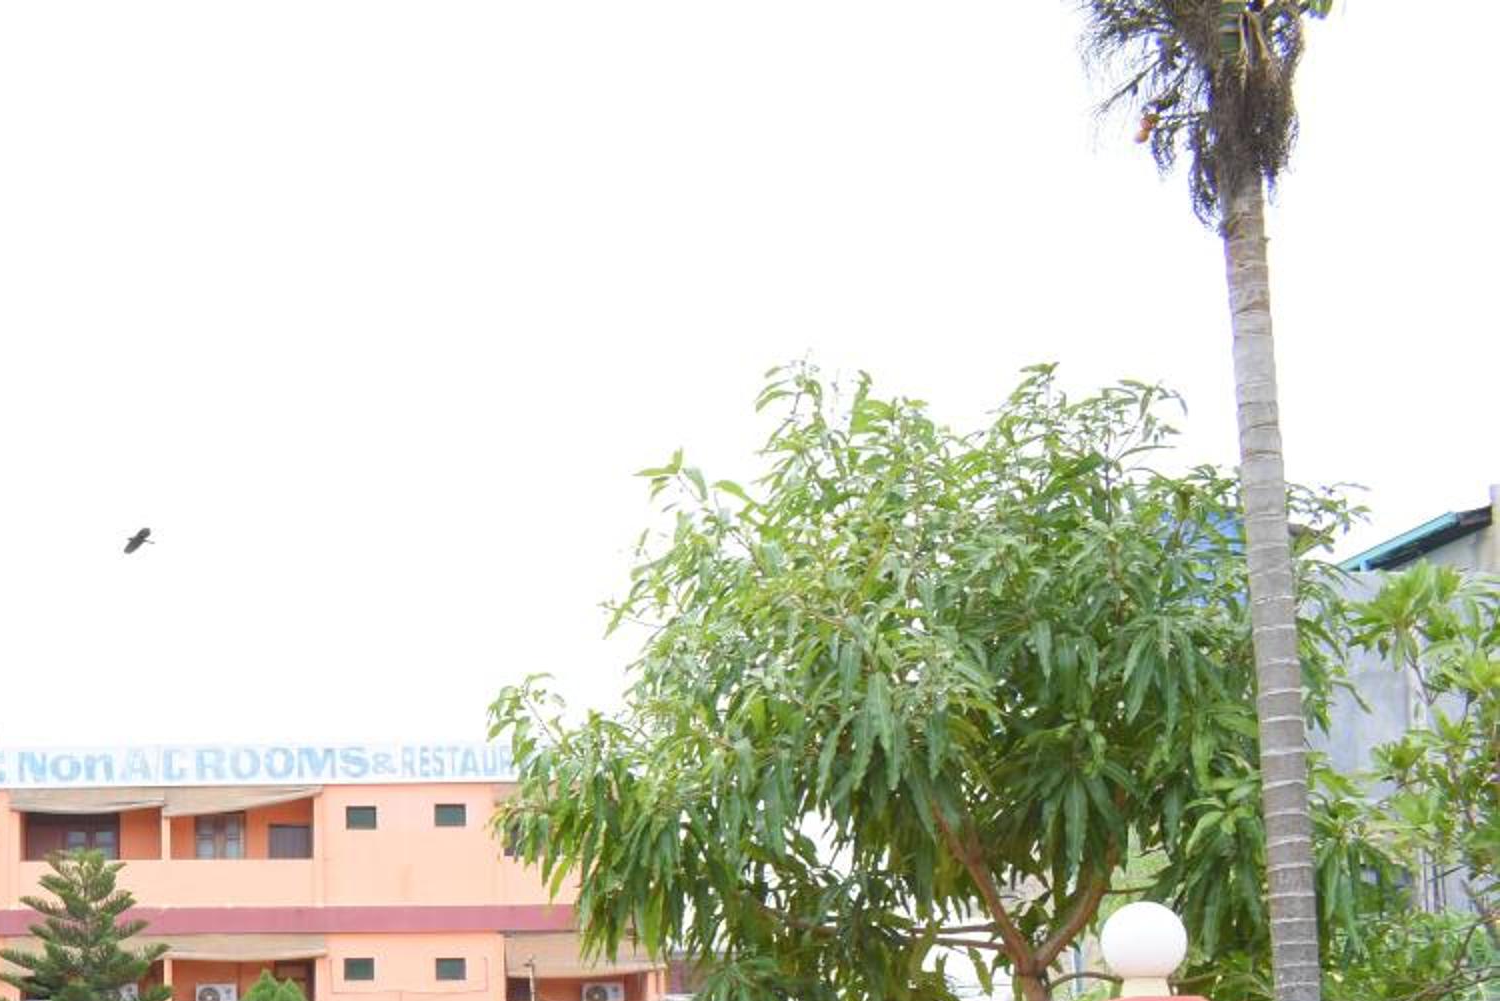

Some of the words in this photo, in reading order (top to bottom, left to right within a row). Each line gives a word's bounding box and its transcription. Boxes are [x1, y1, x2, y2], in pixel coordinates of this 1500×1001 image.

[19, 750, 115, 782] Non
[196, 746, 374, 779] ROOMS
[373, 751, 398, 775] &
